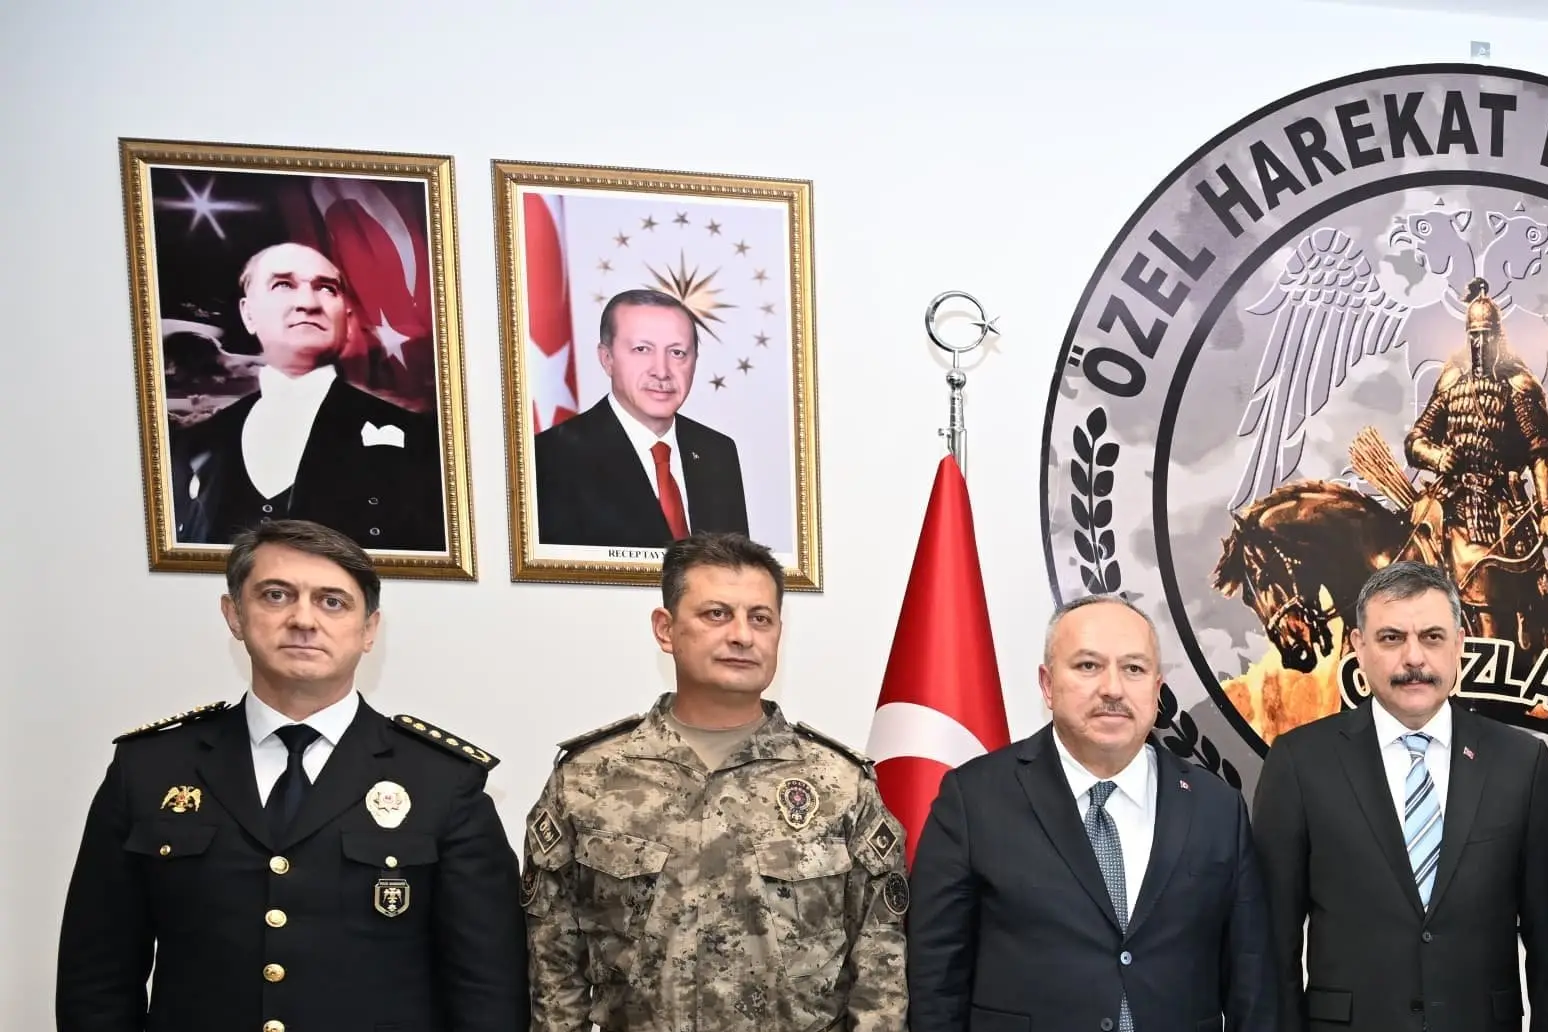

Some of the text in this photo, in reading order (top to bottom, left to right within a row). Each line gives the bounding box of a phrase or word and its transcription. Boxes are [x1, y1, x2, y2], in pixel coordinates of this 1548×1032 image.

[1067, 229, 1217, 398] ÖZEL
[1195, 90, 1518, 239] HAREKAT
[608, 548, 641, 559] RECEP
